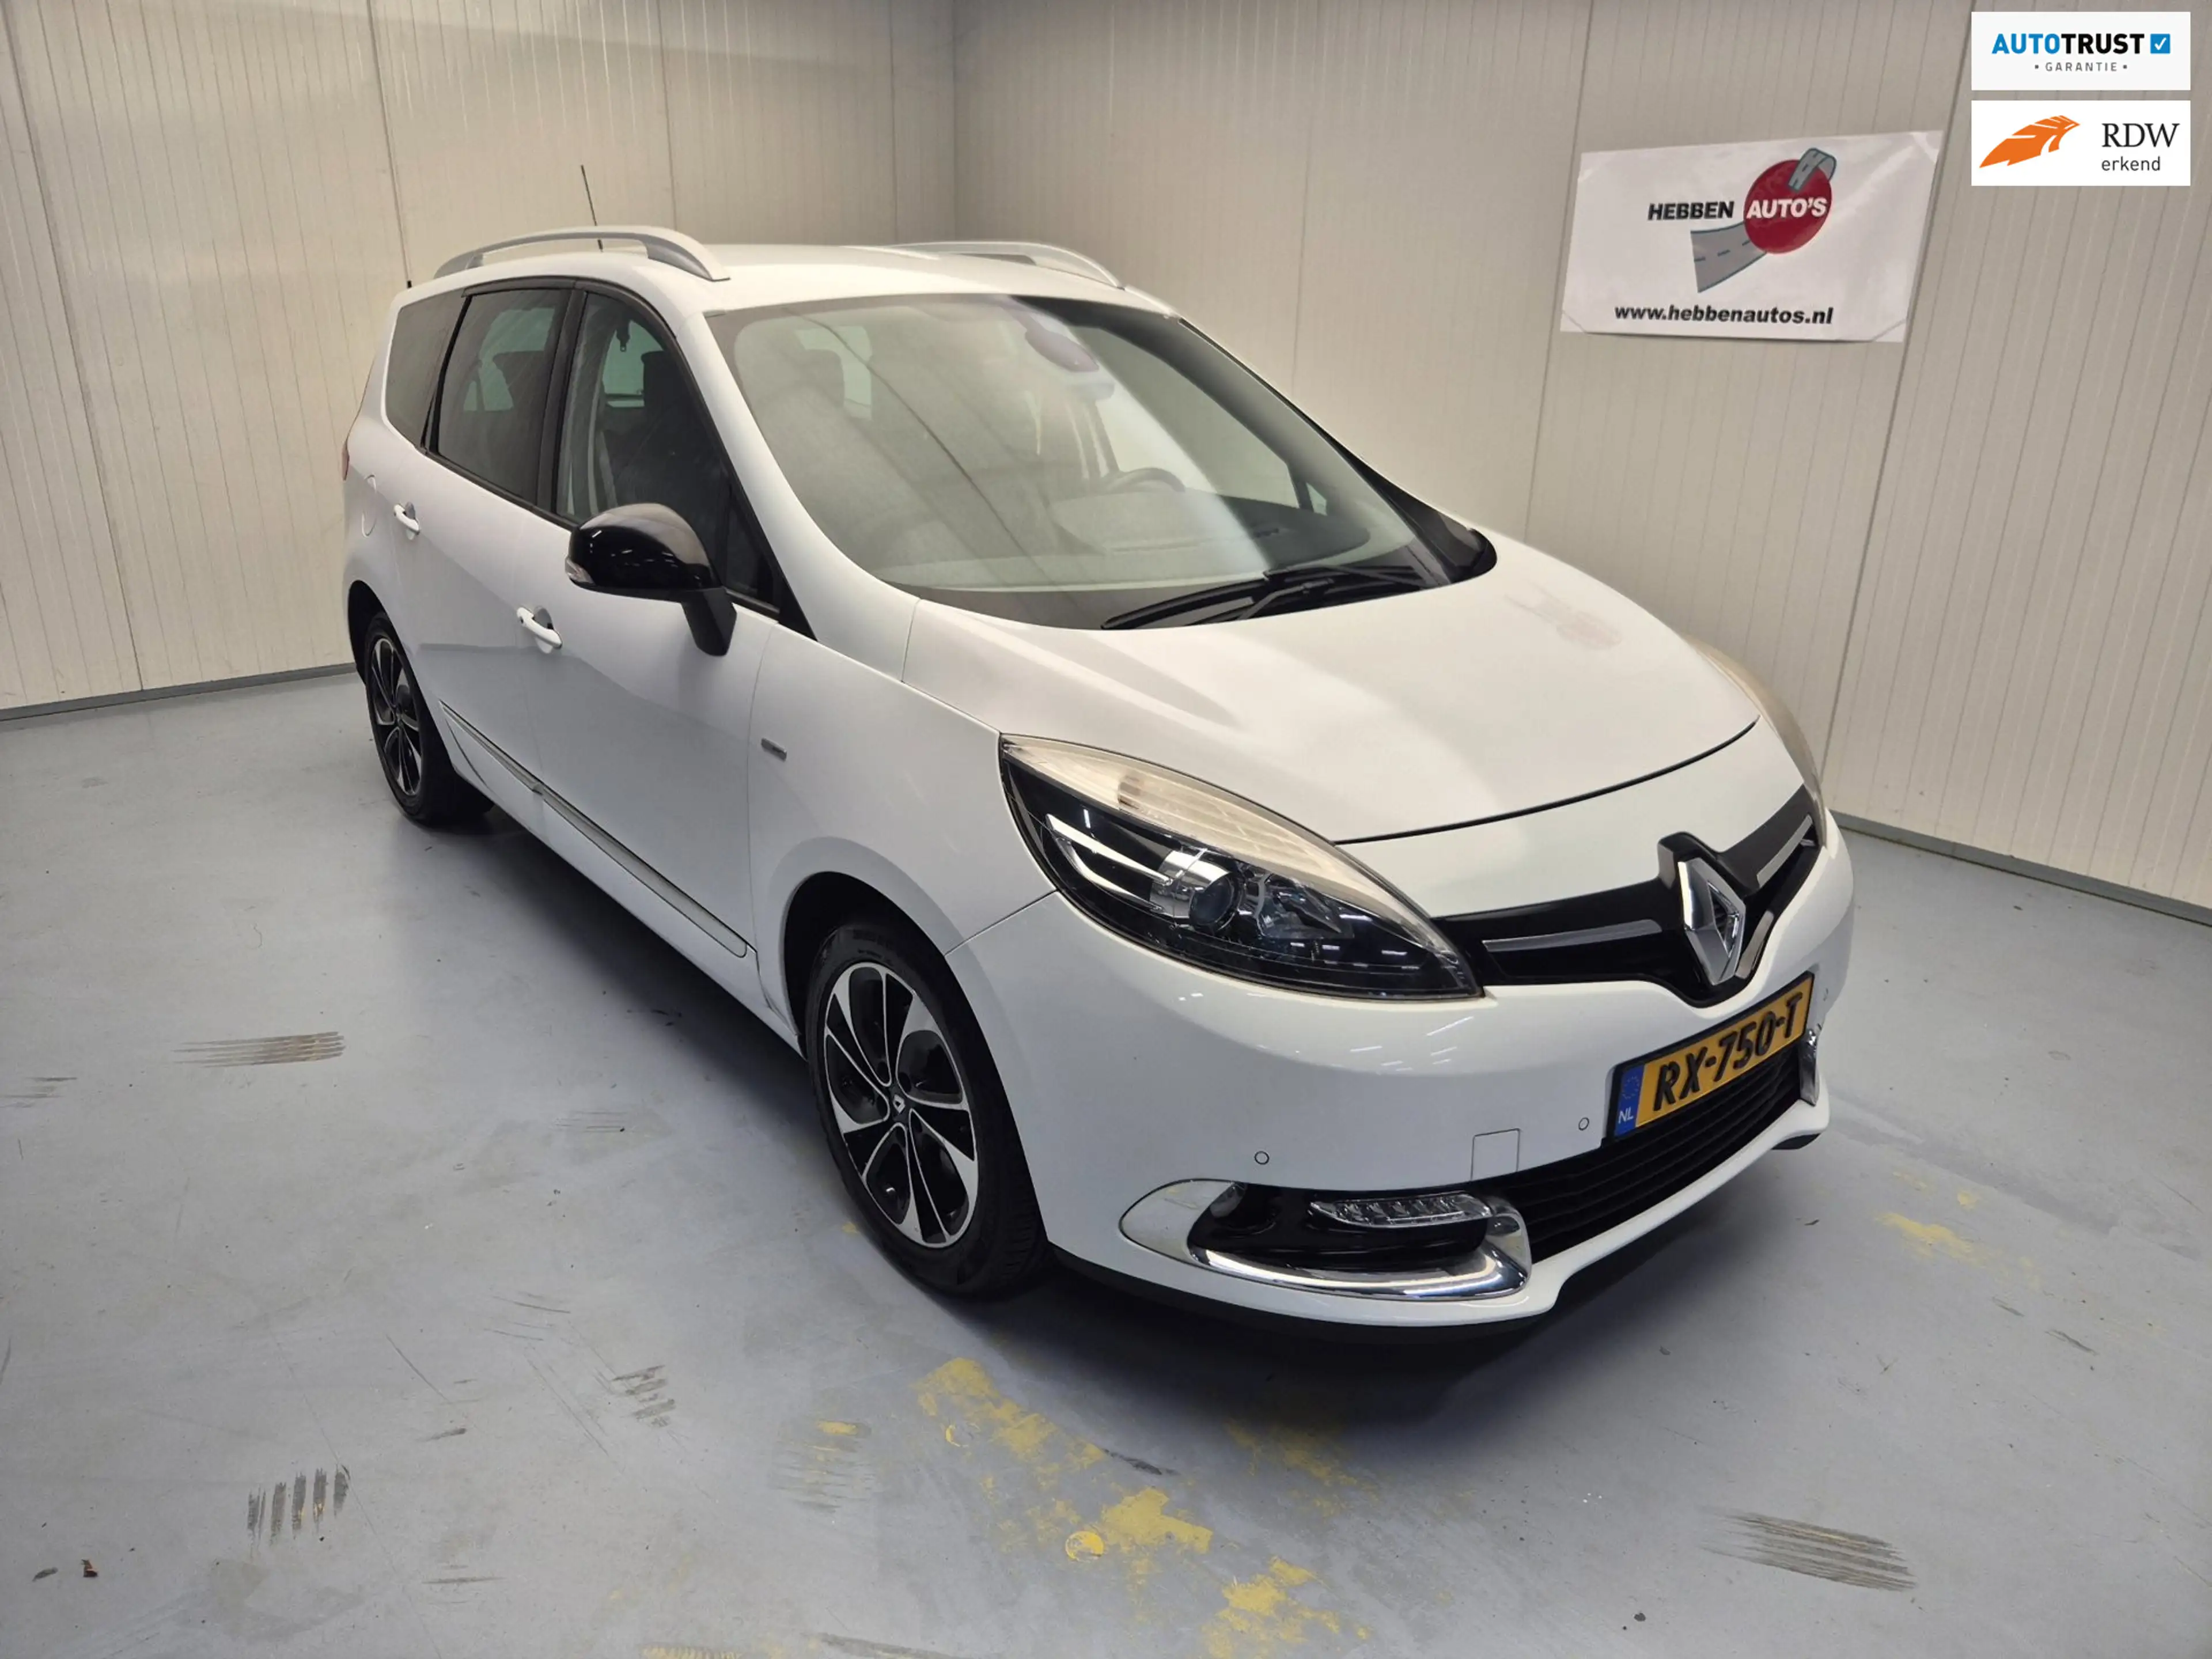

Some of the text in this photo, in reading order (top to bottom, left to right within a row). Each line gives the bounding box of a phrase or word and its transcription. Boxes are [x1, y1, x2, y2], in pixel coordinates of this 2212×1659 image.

[1647, 196, 1828, 221] HEBBEN AUTO'S
[1614, 304, 1834, 326] www.hebbenautos.nl
[1652, 991, 1804, 1112] RX-750-T
[1618, 1106, 1634, 1124] NL
